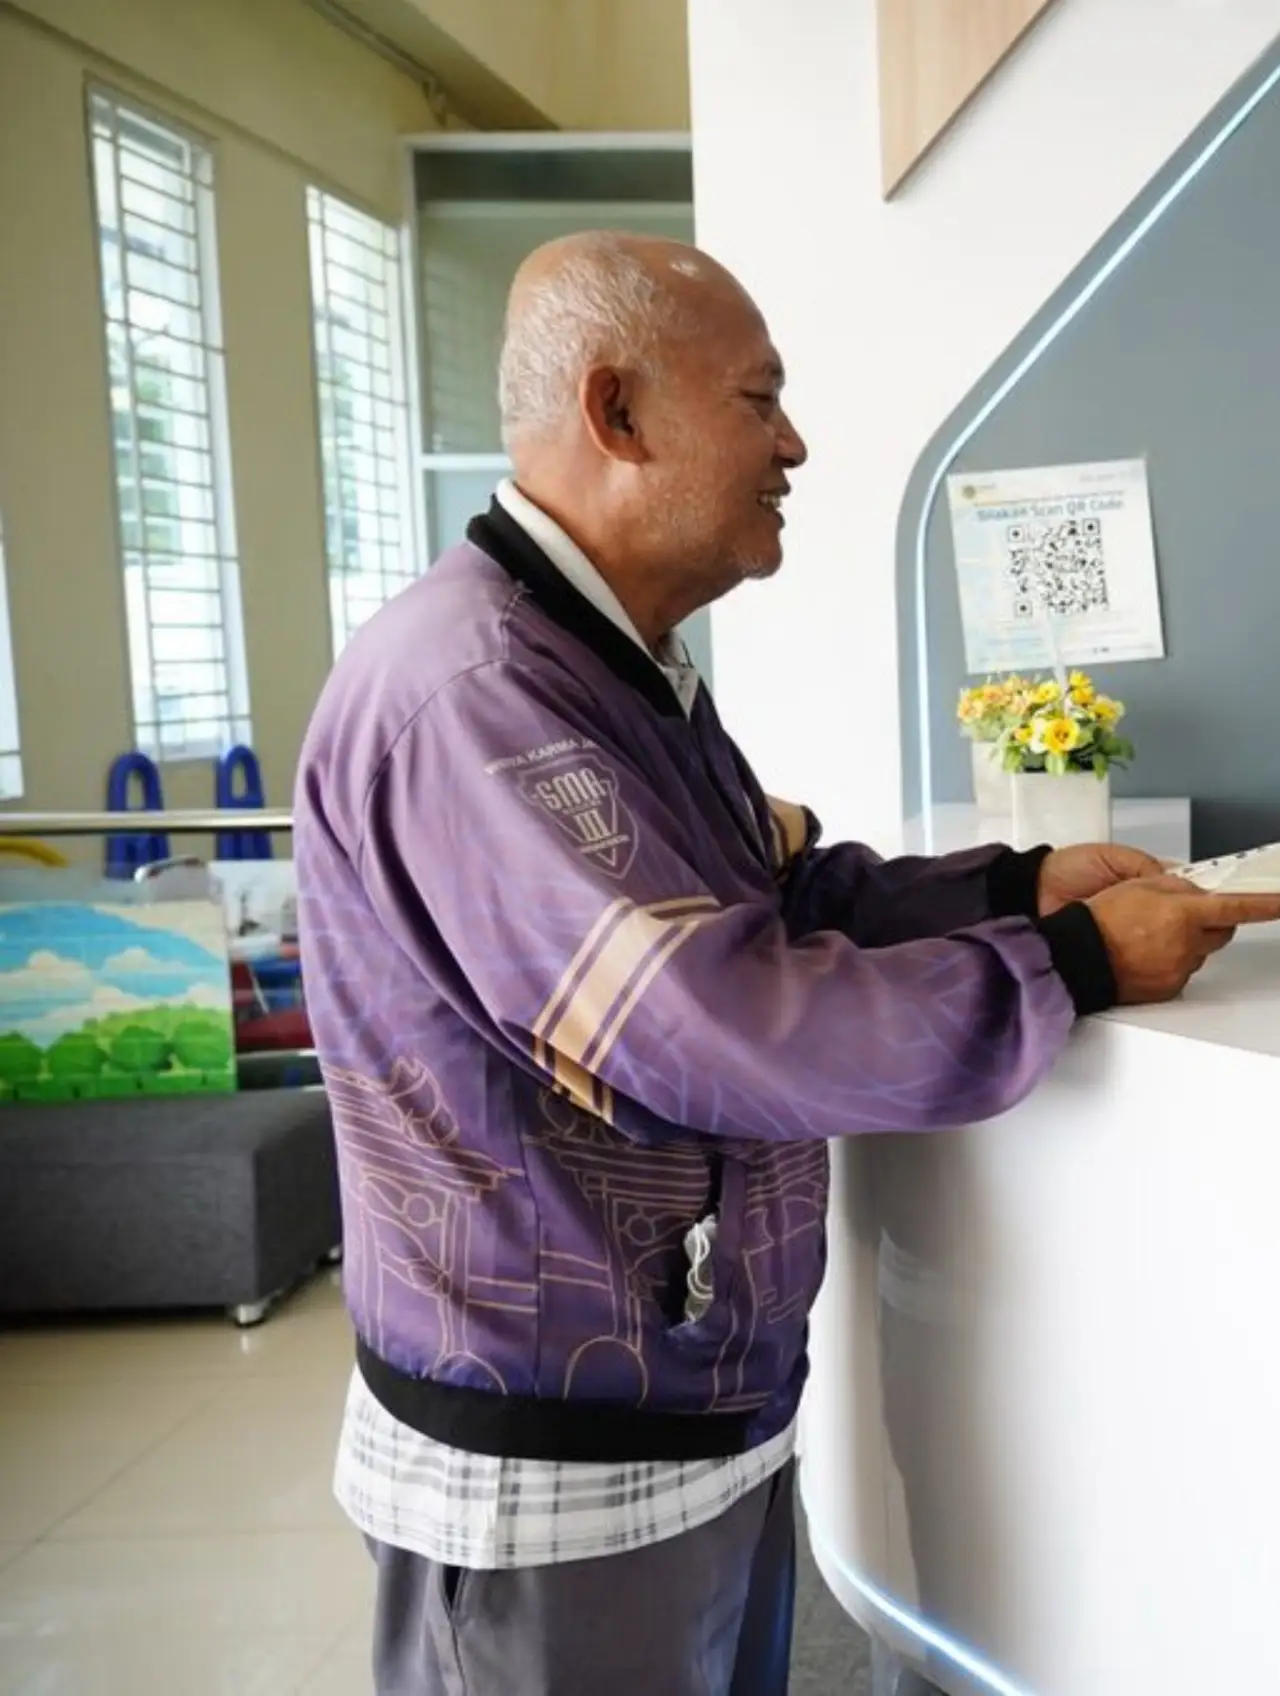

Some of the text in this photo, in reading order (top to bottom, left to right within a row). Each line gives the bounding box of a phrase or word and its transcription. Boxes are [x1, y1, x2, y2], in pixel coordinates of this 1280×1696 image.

[1031, 502, 1064, 518] Scan
[1066, 500, 1086, 517] QR
[535, 767, 607, 811] SMA
